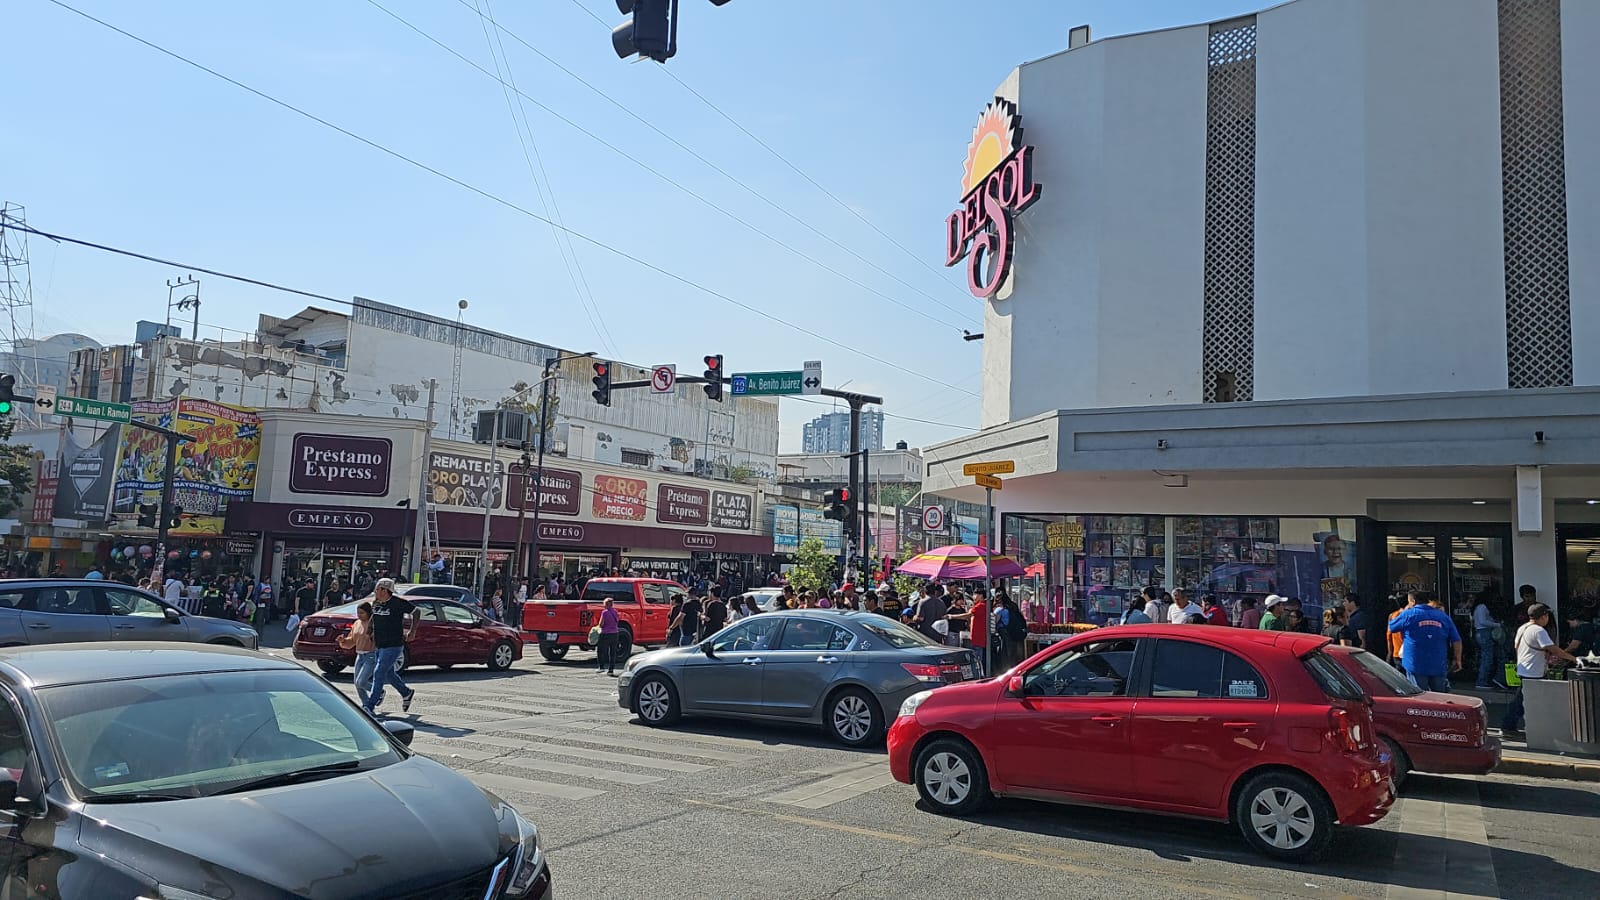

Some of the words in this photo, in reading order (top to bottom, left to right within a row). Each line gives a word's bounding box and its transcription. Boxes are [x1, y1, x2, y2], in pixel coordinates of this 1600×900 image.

[967, 145, 1035, 298] SOL
[748, 379, 758, 390] Av.
[758, 378, 780, 390] Benito
[780, 376, 800, 390] Juárez
[74, 402, 84, 413] Av.
[86, 404, 100, 415] Juan
[107, 406, 129, 419] Ramón
[209, 438, 254, 458] PARTY
[303, 446, 382, 465] Préstamo
[432, 454, 482, 472] REMATE
[484, 462, 500, 473] DE
[429, 470, 460, 484] ORO
[173, 481, 210, 491] MAYOREO
[218, 487, 253, 495] MENUDEO
[606, 478, 638, 494] ORO
[667, 489, 703, 505] Préstamo
[716, 494, 747, 510] PLATA
[606, 505, 634, 515] PRECIO
[727, 510, 746, 518] MEJOR
[298, 513, 364, 526] EMPEÑO
[720, 518, 742, 527] PRECIO
[542, 526, 580, 537] EMPEÑO
[686, 536, 713, 545] EMPEÑO
